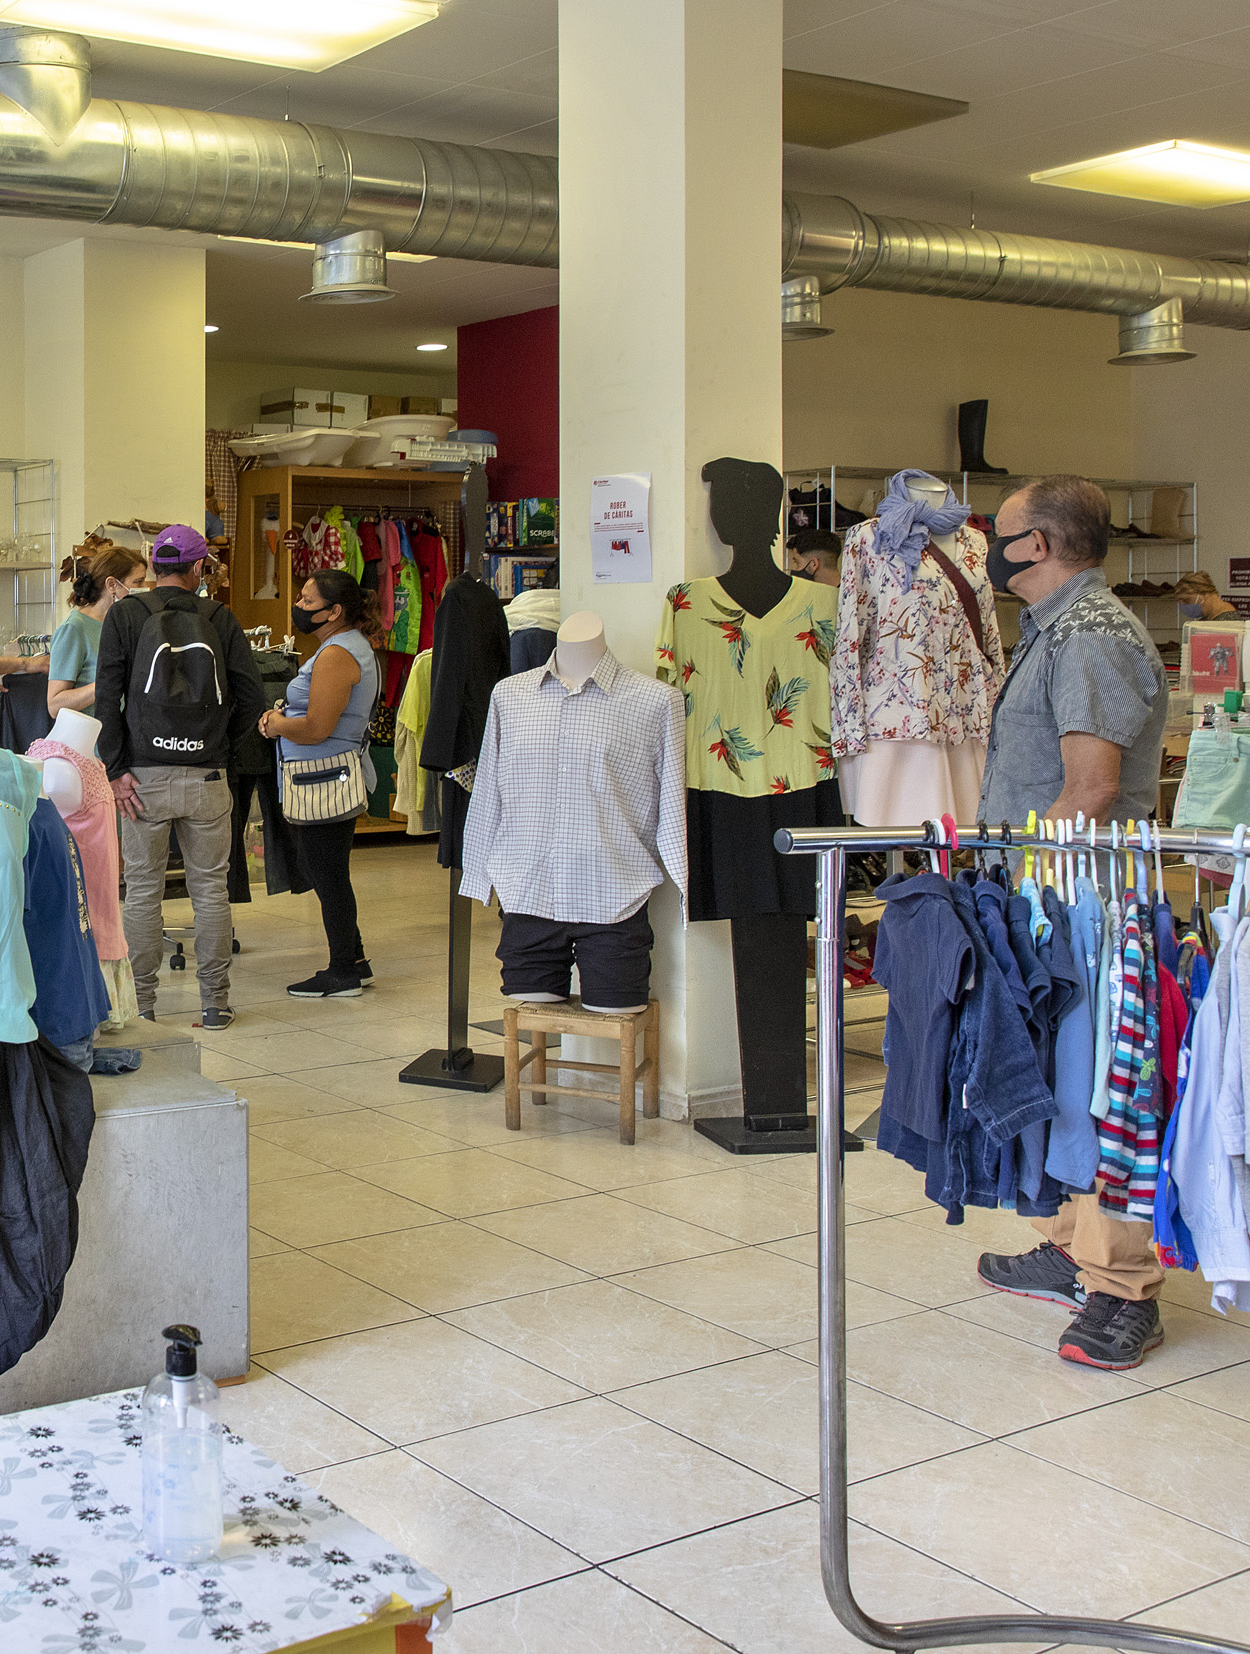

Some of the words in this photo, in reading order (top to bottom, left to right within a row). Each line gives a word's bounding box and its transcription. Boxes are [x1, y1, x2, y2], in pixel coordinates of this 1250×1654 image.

[610, 501, 626, 509] ROBER
[612, 510, 633, 519] CÀRITAS
[152, 736, 205, 752] adidas
